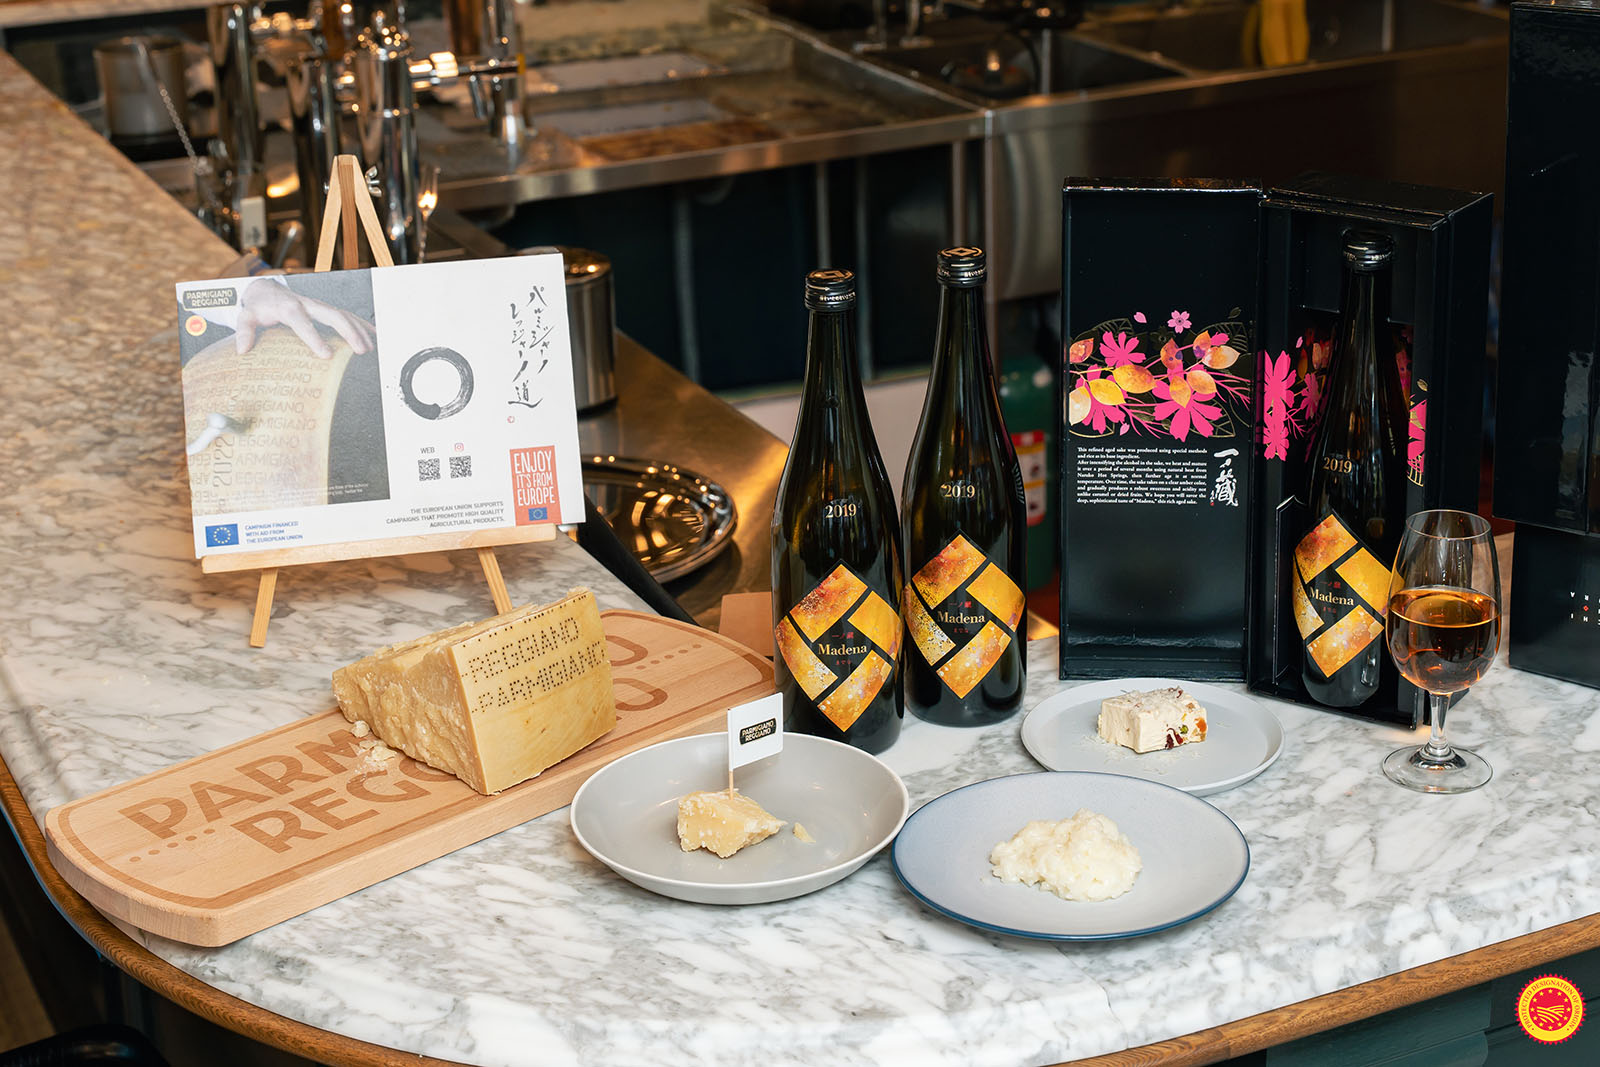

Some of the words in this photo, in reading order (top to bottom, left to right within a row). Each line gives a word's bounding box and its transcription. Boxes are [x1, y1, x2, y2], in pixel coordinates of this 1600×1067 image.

[186, 289, 233, 299] PARMIGIANO
[191, 298, 230, 307] REGGIANO
[420, 446, 435, 454] WEB
[513, 450, 553, 475] ENJOY
[1323, 456, 1353, 474] 2019
[532, 471, 553, 487] FROM
[517, 486, 556, 507] EUROPE
[943, 483, 976, 499] 2019
[386, 516, 420, 525] CAMPAIGNS
[436, 511, 463, 519] PROMOTE
[480, 508, 504, 516] QUALITY
[423, 505, 453, 513] EUROPEAN
[825, 502, 857, 519] 2019
[429, 519, 472, 528] AGRICULTURAL
[473, 516, 505, 524] PRODUCTS.
[258, 535, 286, 543] EUROPEAN
[1309, 586, 1354, 606] Madena
[937, 610, 986, 624] Madena
[818, 643, 867, 656] Madena
